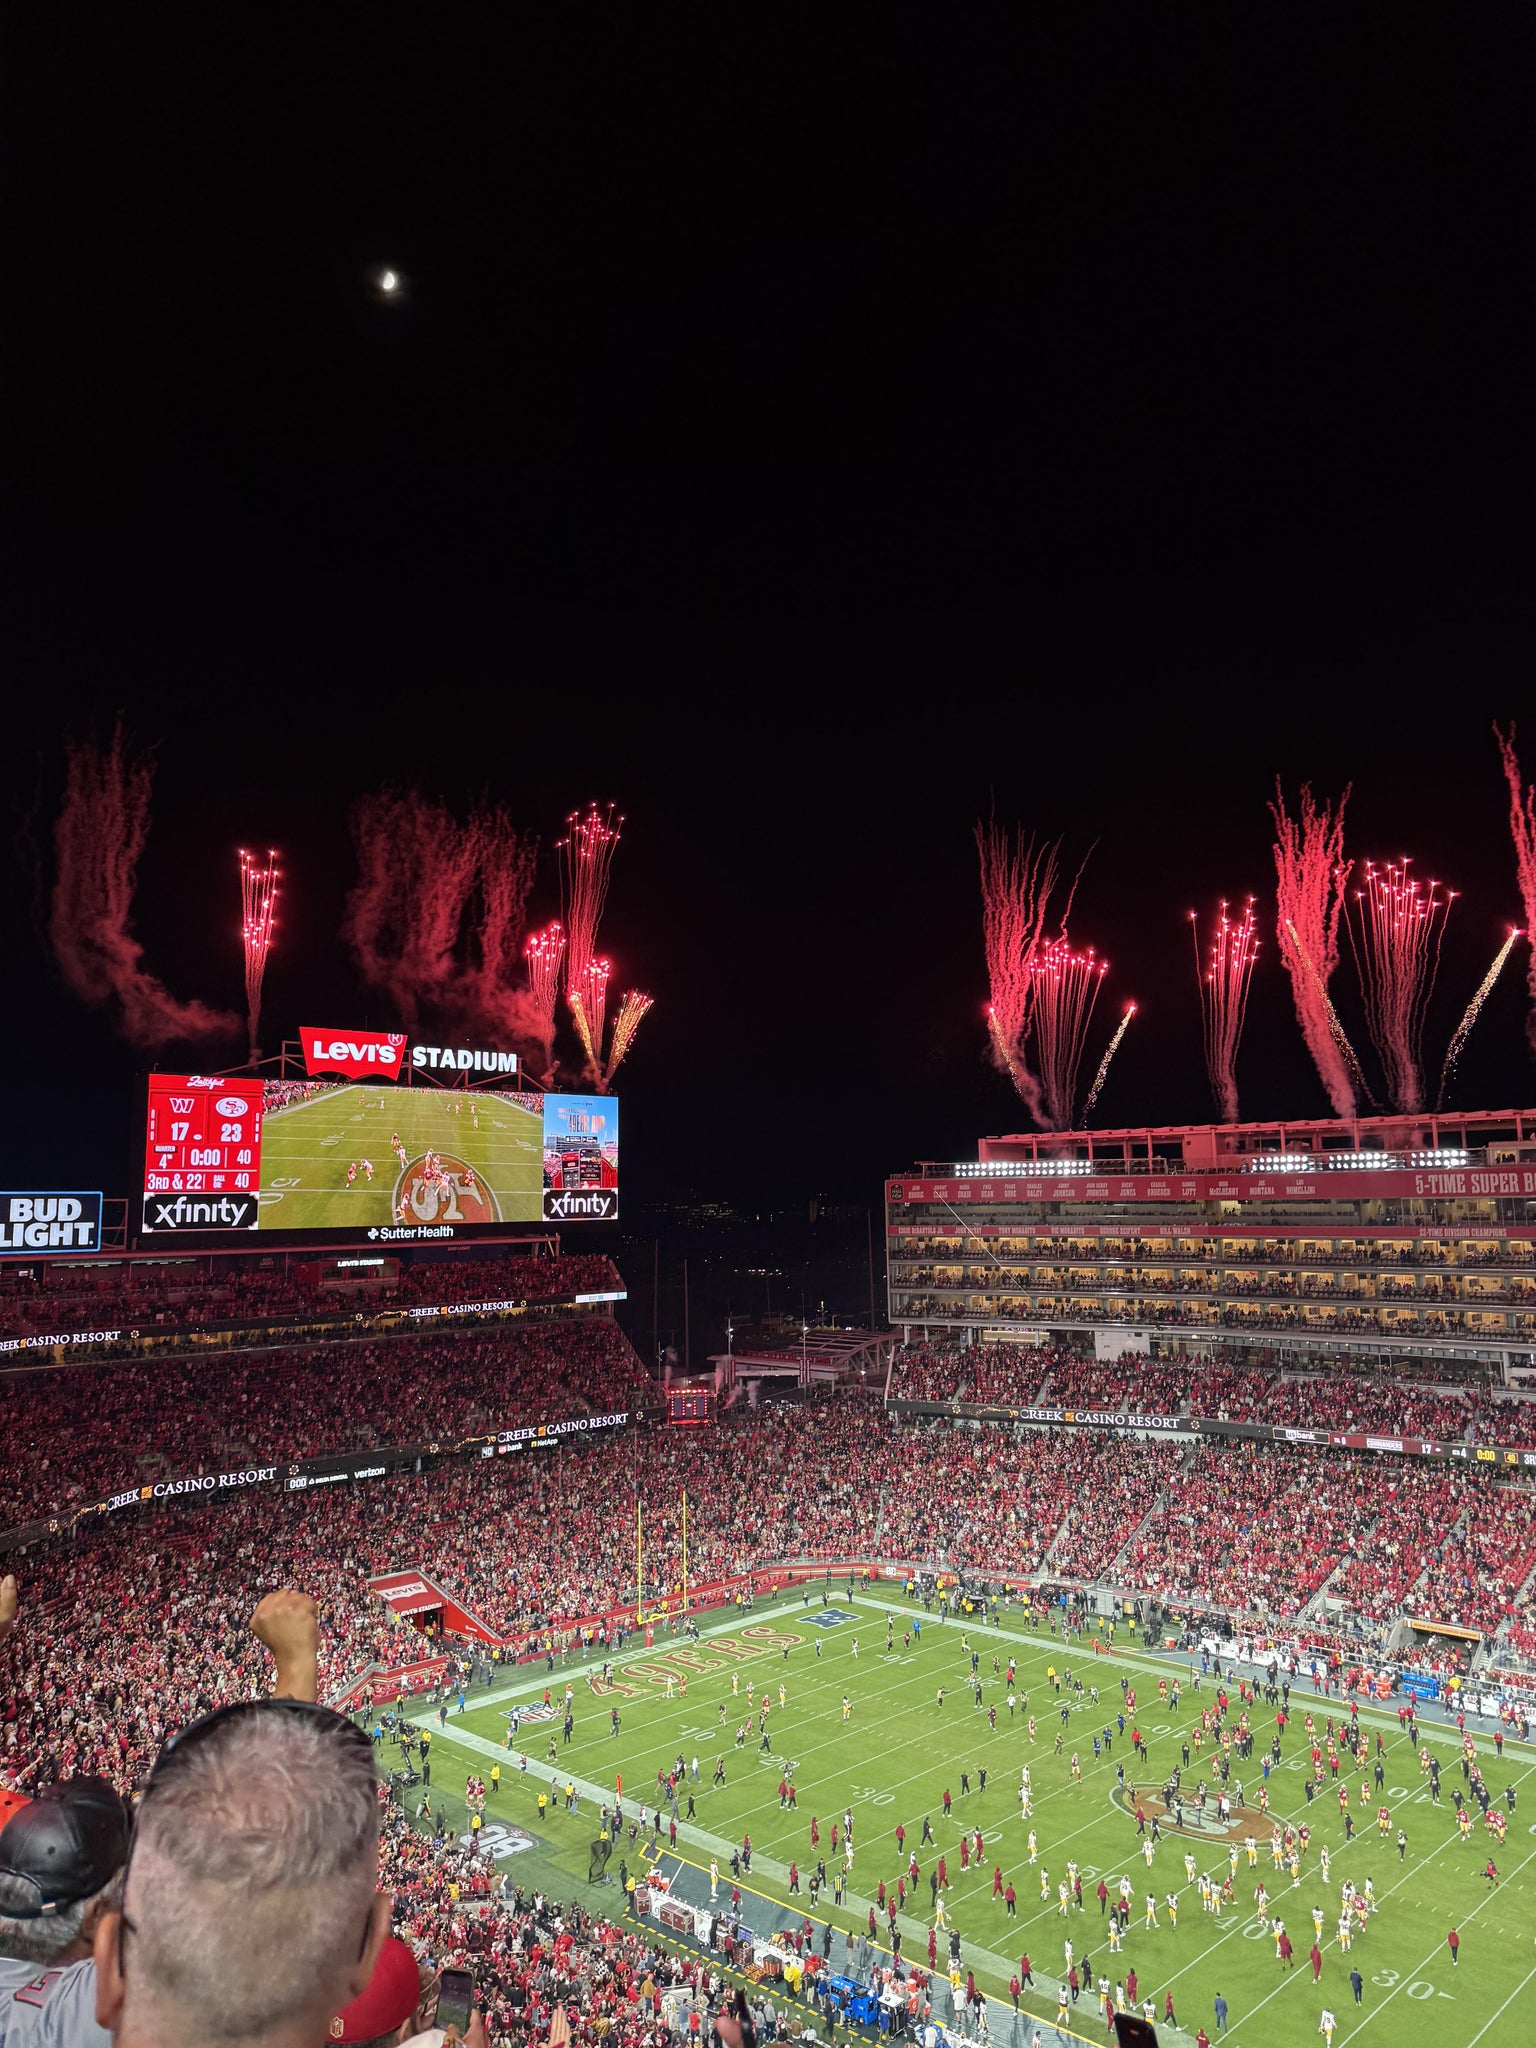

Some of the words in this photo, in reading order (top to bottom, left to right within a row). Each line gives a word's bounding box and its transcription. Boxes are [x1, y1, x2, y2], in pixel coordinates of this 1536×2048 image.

[413, 1046, 517, 1072] STADIUM
[186, 1075, 224, 1090] Faithful
[171, 1122, 189, 1141] 17
[221, 1123, 242, 1142] 23
[190, 1149, 221, 1167] 0:00
[237, 1150, 251, 1165] 40
[148, 1173, 169, 1190] 3RD
[172, 1173, 183, 1189] &
[186, 1174, 202, 1190] 22
[235, 1173, 249, 1188] 40
[1415, 1173, 1466, 1194] 5-TIME
[1471, 1172, 1520, 1194] SUPER
[9, 1198, 82, 1222] BUD
[155, 1196, 248, 1228] xfinity
[551, 1191, 611, 1217] xfinity
[380, 1227, 416, 1240] Sutter
[418, 1226, 453, 1238] Health
[1444, 1228, 1469, 1237] DIVISION
[1471, 1228, 1507, 1237] CHAMPIONS
[408, 1306, 440, 1318] CREEK
[447, 1303, 481, 1314] CASINO
[482, 1300, 514, 1311] RESORT
[26, 1334, 70, 1347] CASINO
[73, 1331, 121, 1343] RESORT
[1020, 1409, 1063, 1421] CREEK
[1075, 1412, 1125, 1426] CASINO
[1128, 1416, 1180, 1429] RESORT
[498, 1428, 537, 1444] CREEK
[547, 1419, 588, 1435] CASINO
[590, 1413, 628, 1428] RESORT
[1297, 1431, 1316, 1441] bank
[507, 1442, 522, 1452] bank
[537, 1438, 558, 1447] NetApp
[1421, 1443, 1432, 1454] 17
[1460, 1448, 1467, 1458] 4
[1477, 1449, 1496, 1461] 0:00
[1506, 1453, 1516, 1462] 40
[1524, 1454, 1536, 1465] 3R
[354, 1465, 386, 1479] verizon
[106, 1488, 139, 1512] CREEK
[153, 1476, 215, 1497] CASINO
[218, 1467, 276, 1488] RESORT
[885, 1567, 897, 1576] 80
[589, 1627, 805, 1698] 49ERS
[1214, 1915, 1269, 1940] 40
[1371, 1968, 1436, 2000] 30
